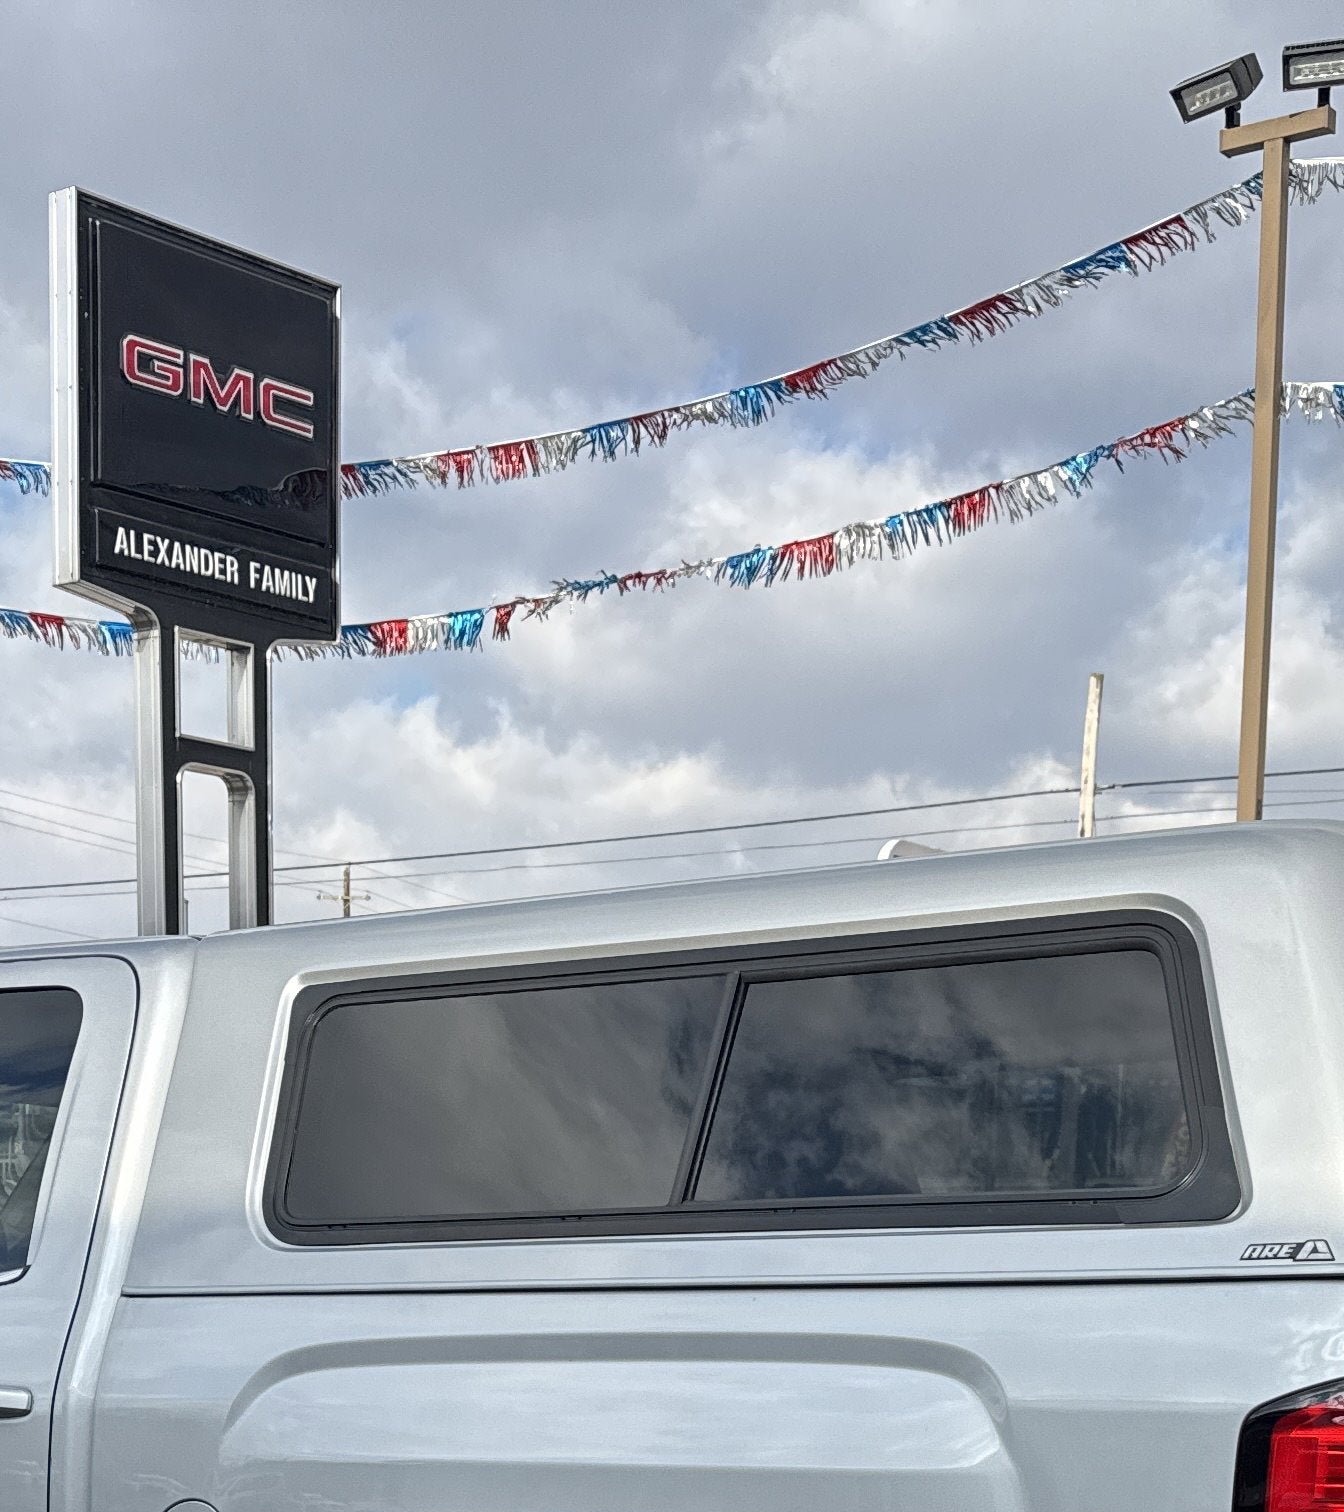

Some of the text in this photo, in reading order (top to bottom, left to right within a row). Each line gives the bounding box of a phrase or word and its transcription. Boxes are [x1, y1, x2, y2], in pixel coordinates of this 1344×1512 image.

[121, 333, 316, 440] GMC
[114, 526, 318, 604] ALEXANDER FAMILY
